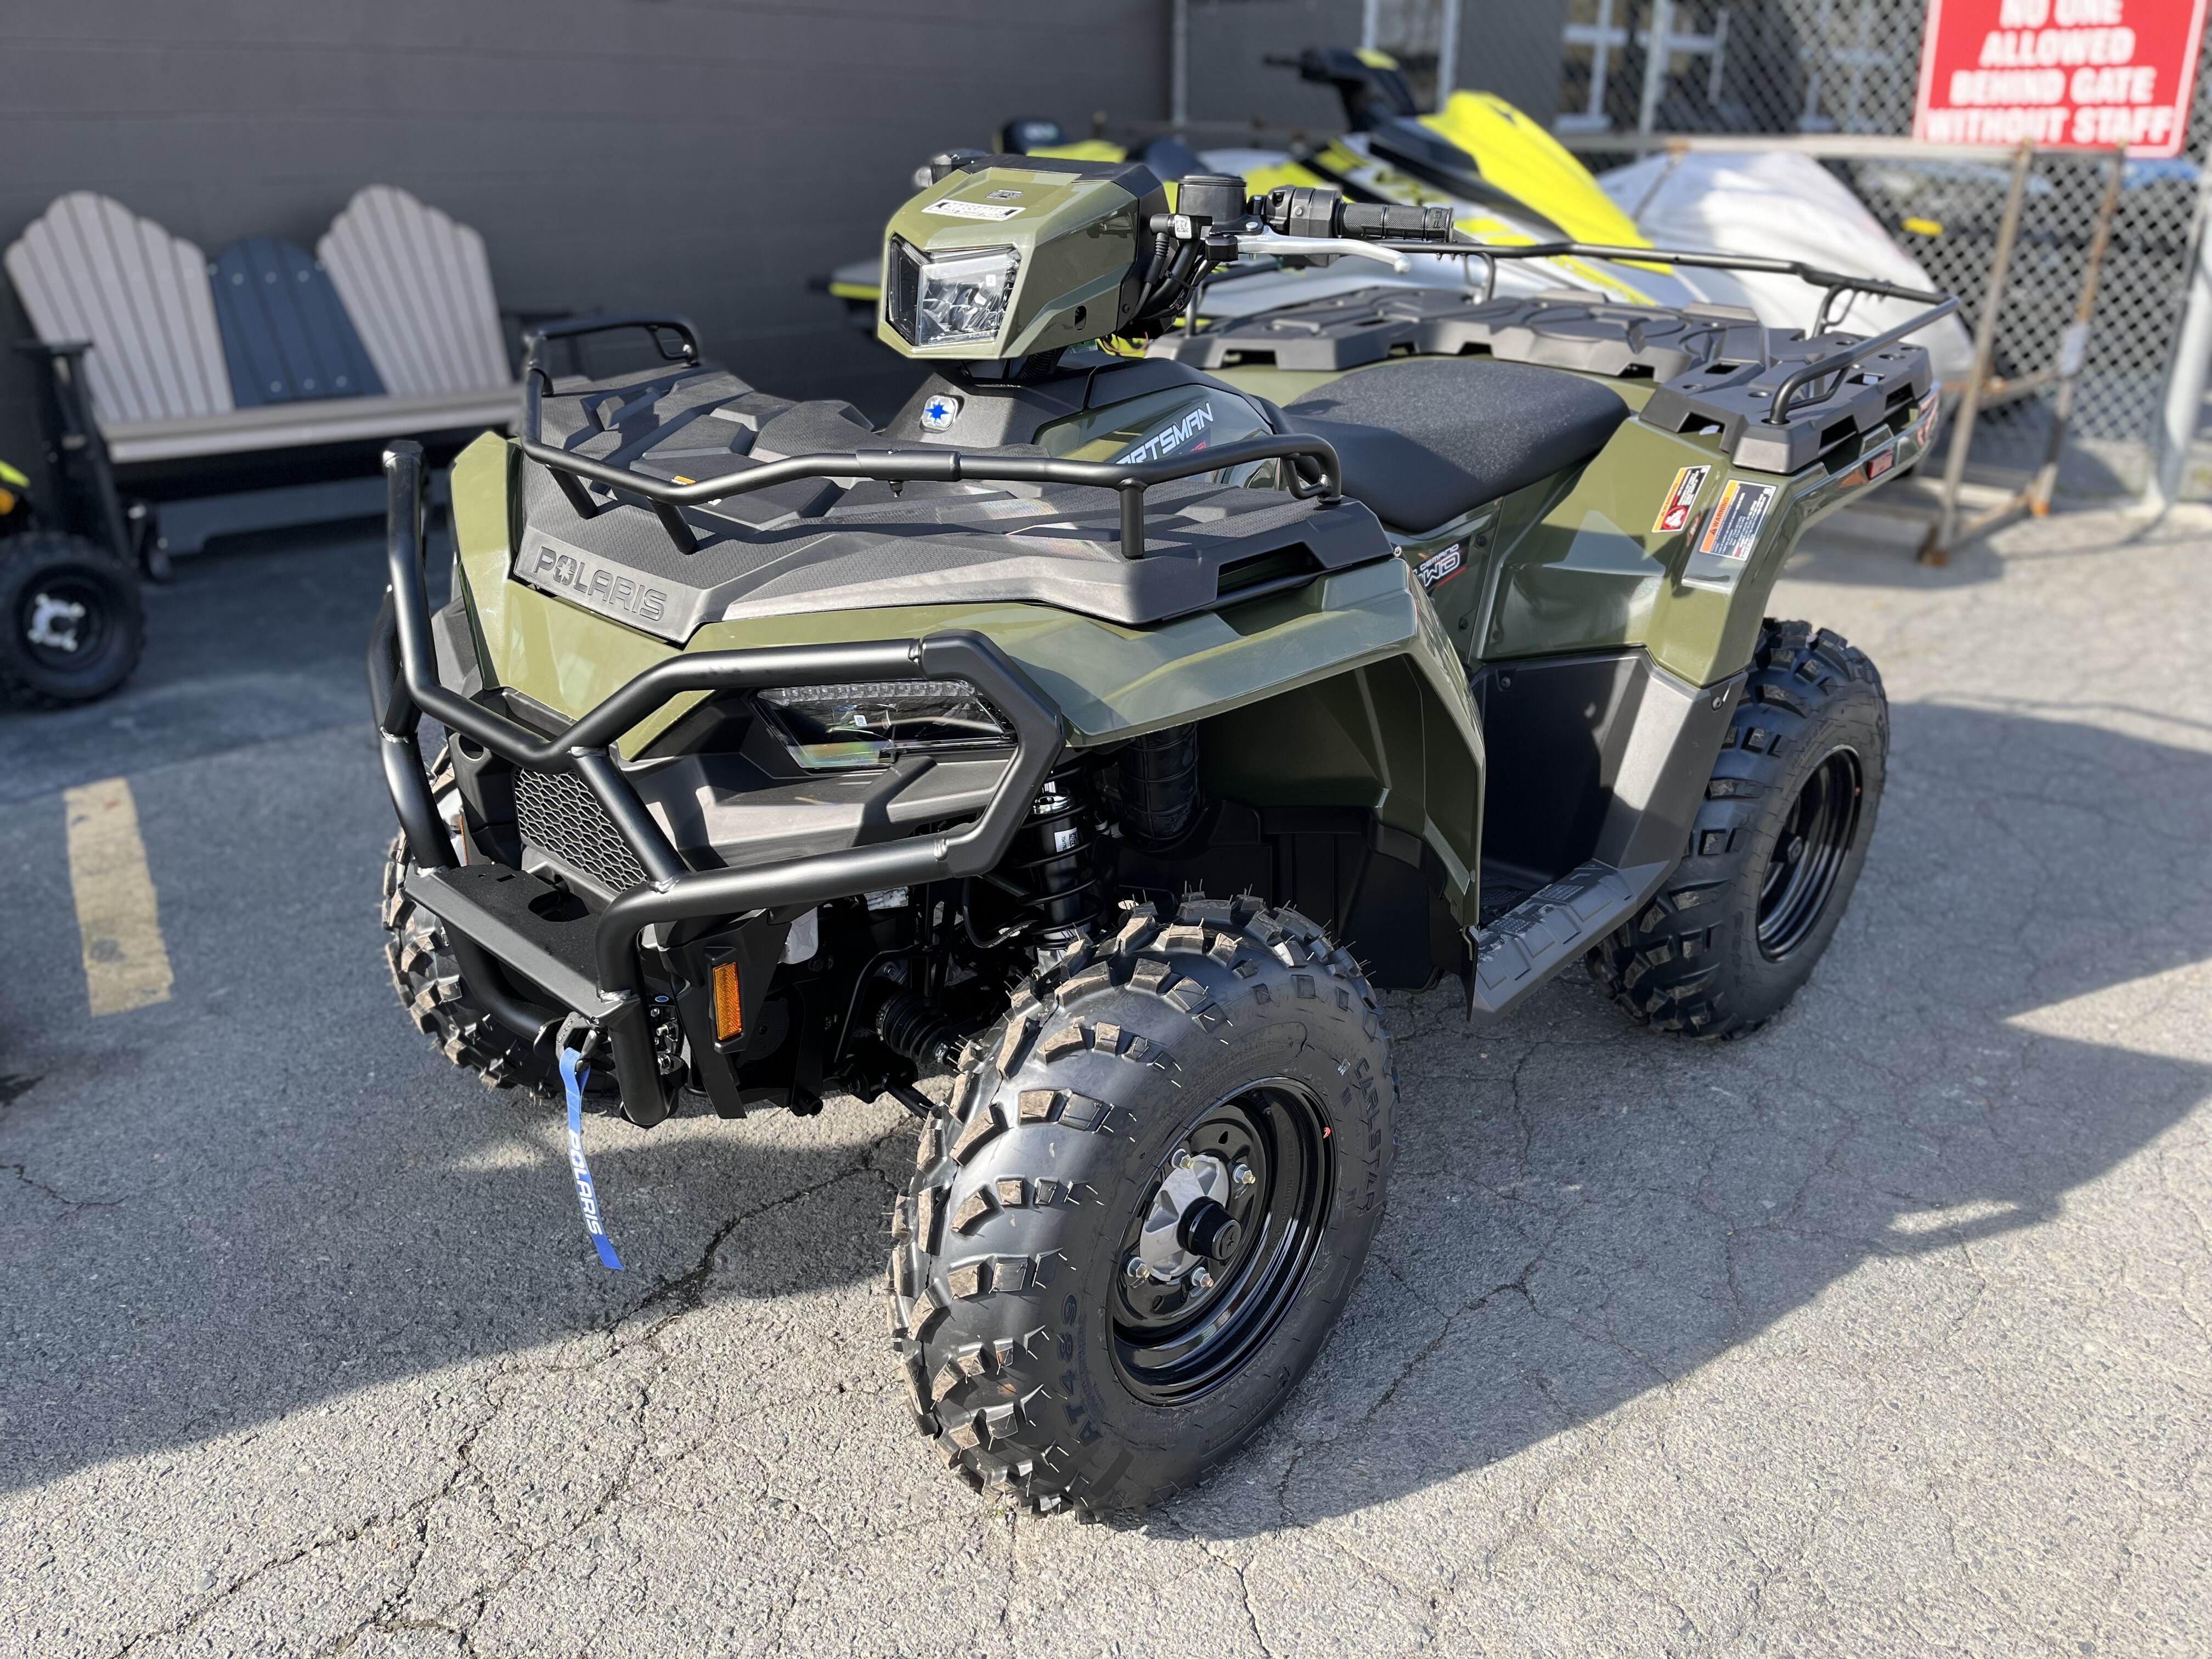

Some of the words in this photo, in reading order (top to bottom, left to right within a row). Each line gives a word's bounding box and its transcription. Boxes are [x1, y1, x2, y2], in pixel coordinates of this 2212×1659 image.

[1999, 0, 2050, 28] NO
[2054, 0, 2124, 26] ONE
[1978, 26, 2136, 67] ALLOWED
[1949, 67, 2066, 106] BEHIND
[2070, 66, 2157, 104] GATE
[1926, 106, 2070, 144] WITHOUT
[2072, 106, 2175, 144] STAFF
[1712, 496, 1730, 528] WARNING
[1420, 543, 1459, 571] DEMAND
[533, 546, 668, 622] POLARIS
[1354, 1057, 1382, 1213] CARLSTAR
[568, 1128, 603, 1235] POLARIS
